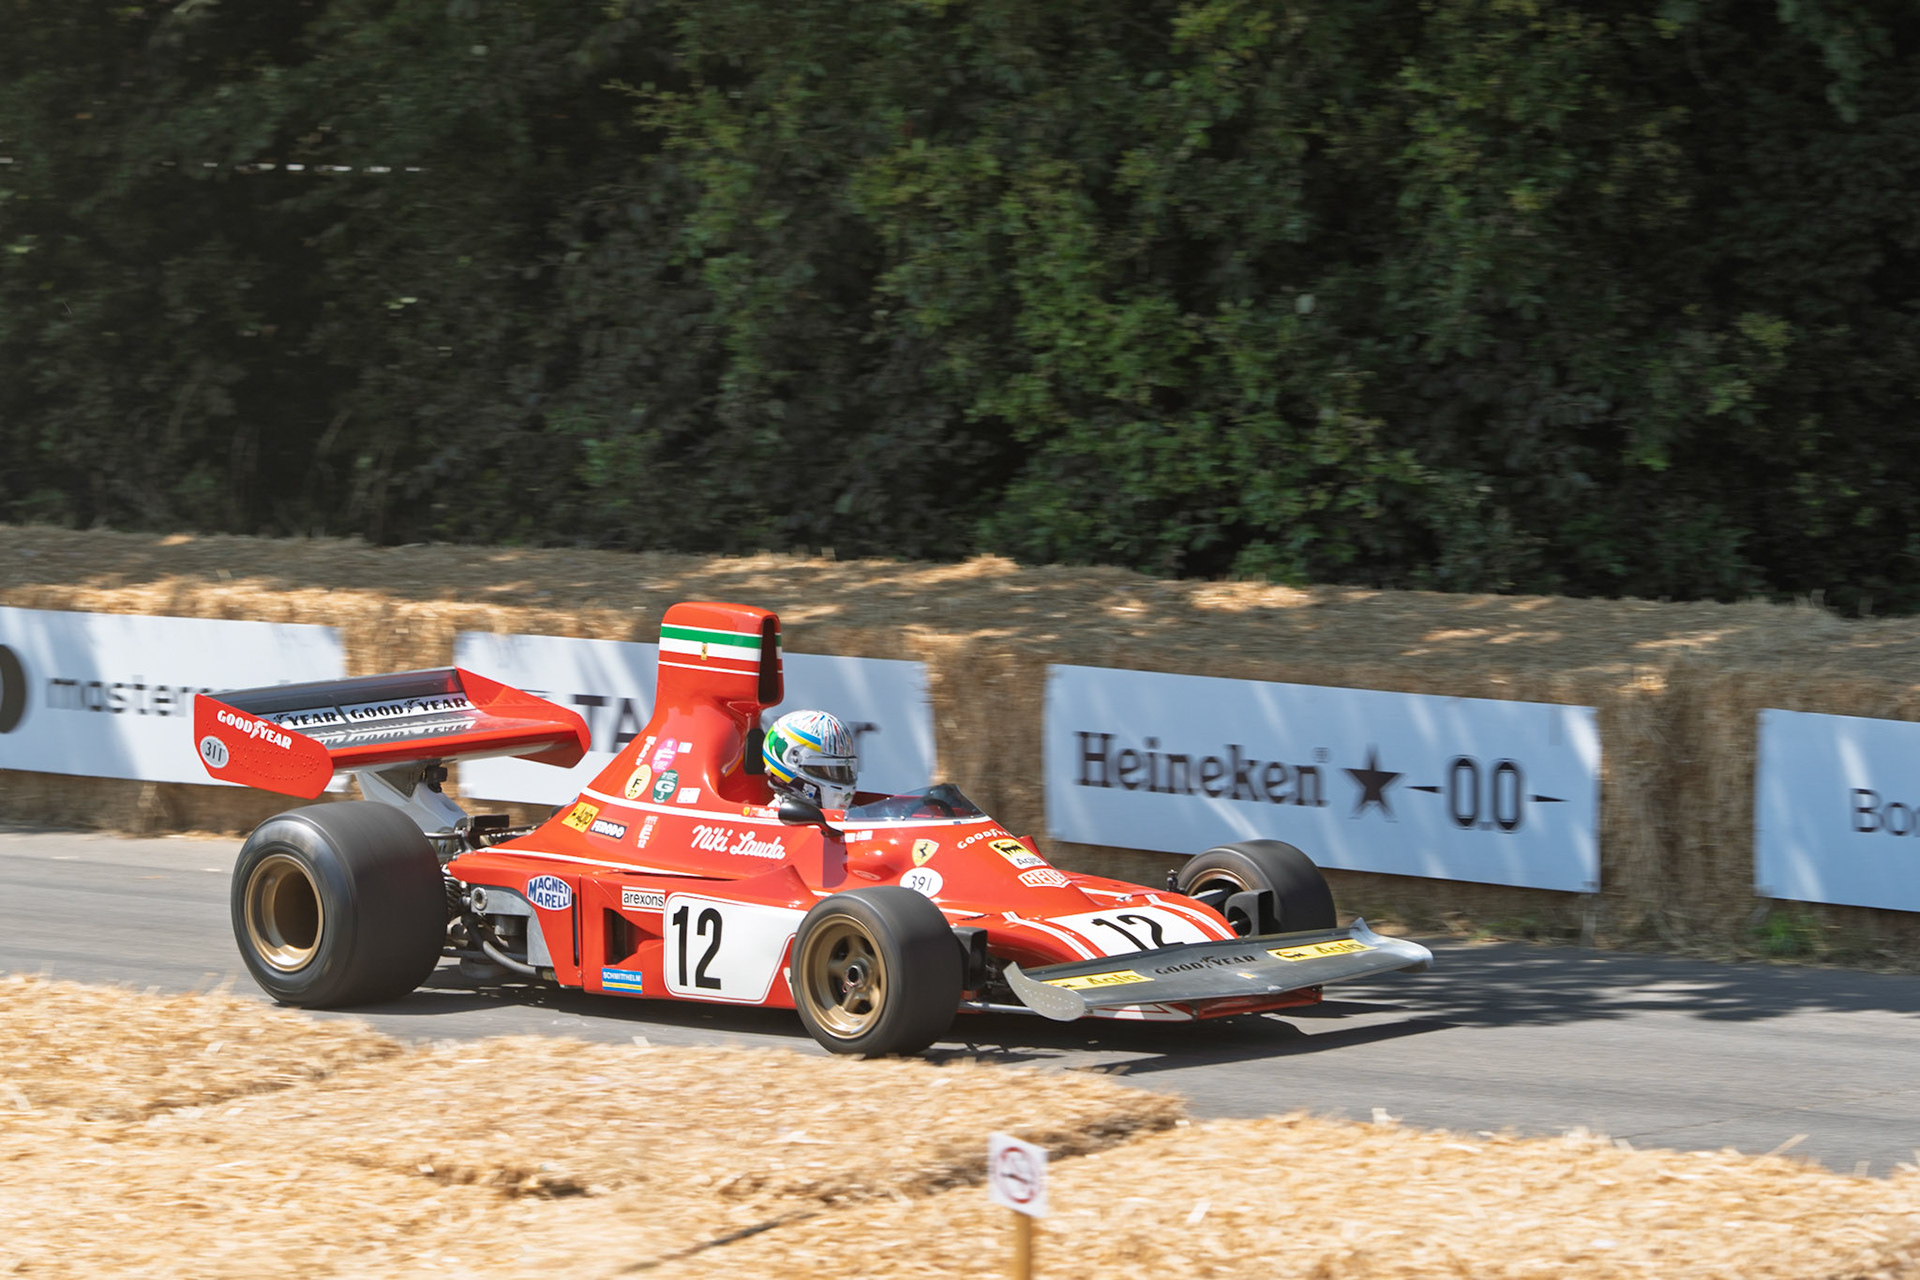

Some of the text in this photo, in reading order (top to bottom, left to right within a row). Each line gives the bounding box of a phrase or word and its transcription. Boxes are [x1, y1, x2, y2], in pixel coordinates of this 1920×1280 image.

[46, 675, 240, 718] master
[205, 741, 224, 762] 311
[1074, 730, 1329, 808] Heineken
[591, 819, 626, 839] FERODO
[1849, 787, 1920, 838] Bo
[690, 824, 786, 860] Niki Lauda
[528, 876, 571, 897] MAGNETI
[623, 892, 664, 907] arexons
[911, 875, 932, 891] 391
[672, 905, 722, 990] 12
[1091, 914, 1187, 951] 12
